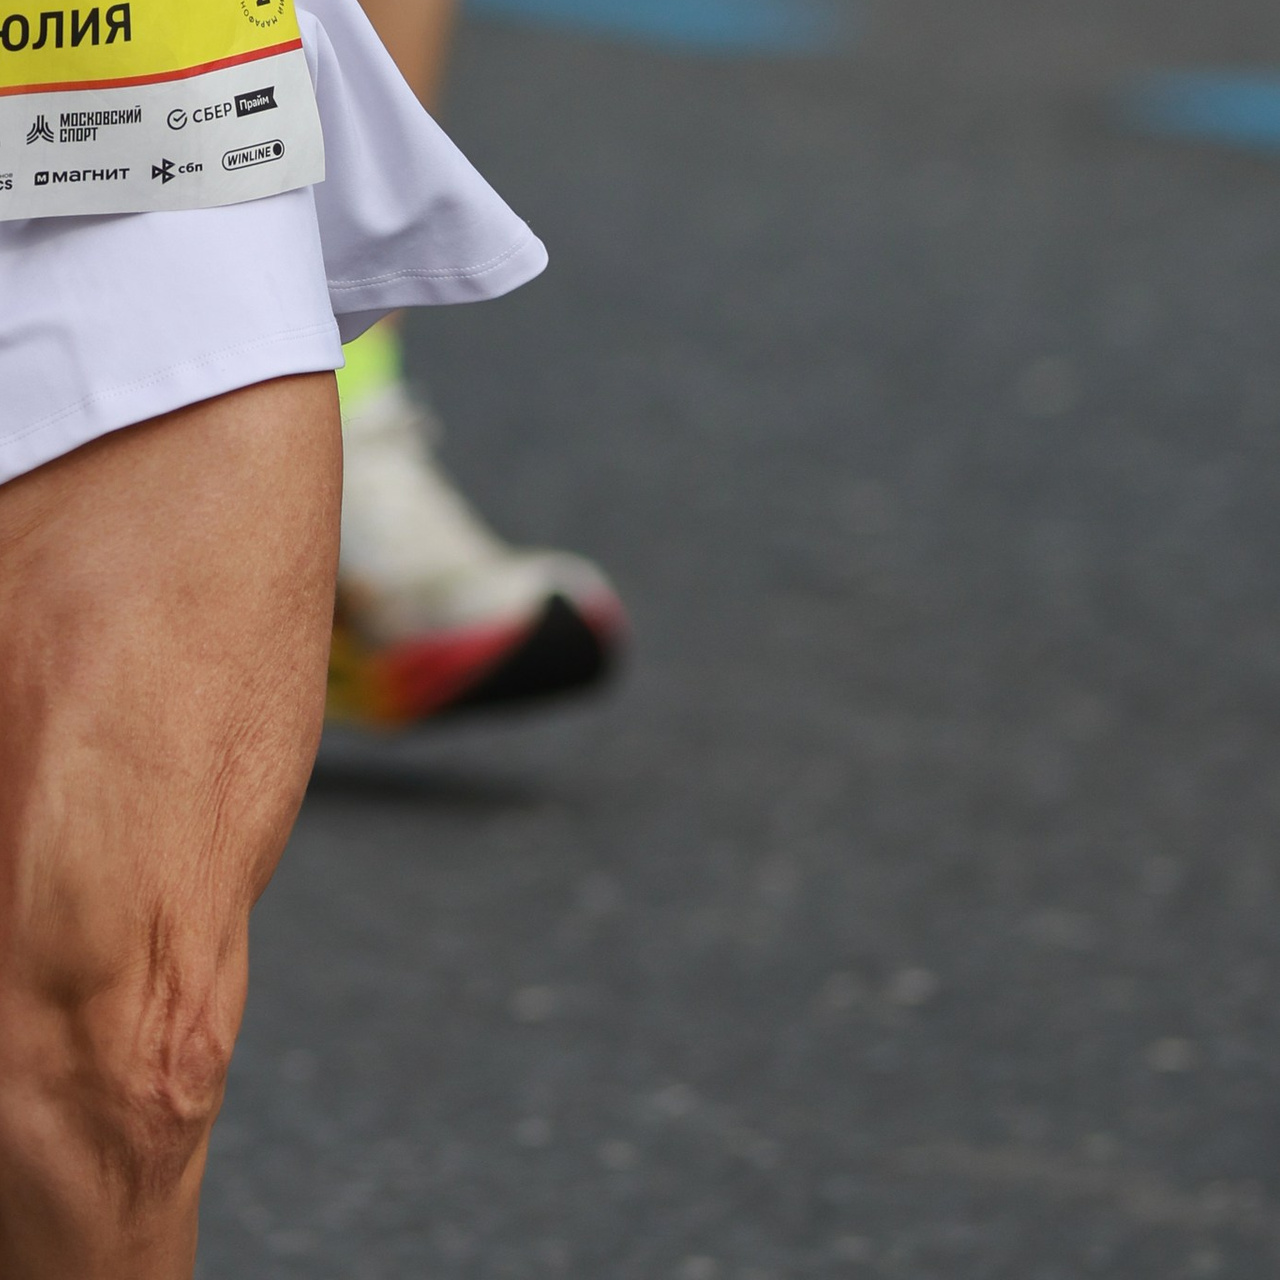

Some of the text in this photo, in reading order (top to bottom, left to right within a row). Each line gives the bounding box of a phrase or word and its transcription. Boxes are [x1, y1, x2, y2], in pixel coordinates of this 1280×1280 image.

[59, 105, 142, 128] МОСКОВСКИЙ
[192, 94, 270, 124] СБЕР Прайм
[59, 127, 99, 143] СПОРТ
[227, 147, 271, 167] WINLINE
